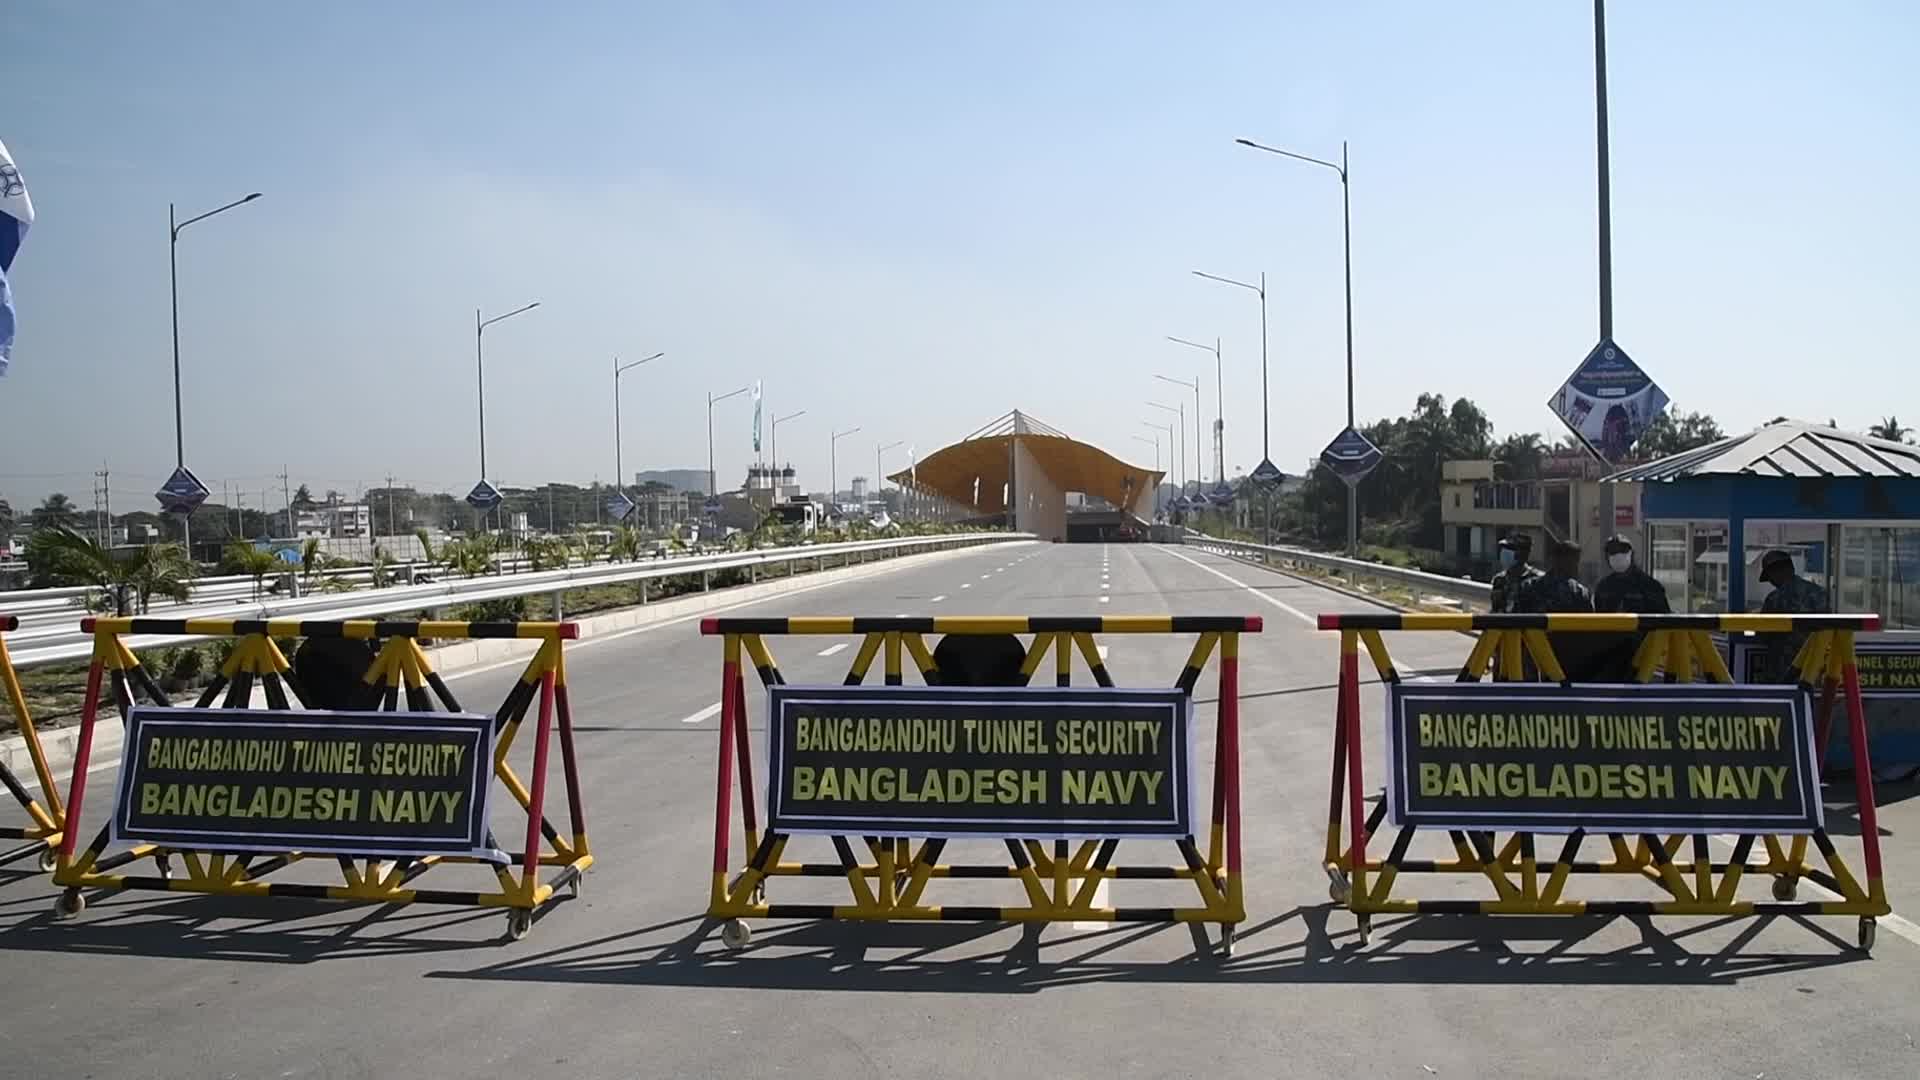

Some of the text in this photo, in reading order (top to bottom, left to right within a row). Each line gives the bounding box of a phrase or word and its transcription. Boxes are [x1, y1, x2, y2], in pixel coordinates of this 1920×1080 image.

[1856, 656, 1884, 669] NNEL
[796, 717, 1162, 755] BANGABANDHU TUNNEL SECURITY
[1419, 713, 1782, 752] BANGABANDHU TUNNEL SECURITY
[148, 737, 466, 777] BANGABANDHU TUNNEL SECURITY
[792, 766, 1164, 806] BANGLADESH NAVY
[1419, 762, 1790, 800] BANGLADESH NAVY
[140, 783, 464, 824] BANGLADESH NAVY
